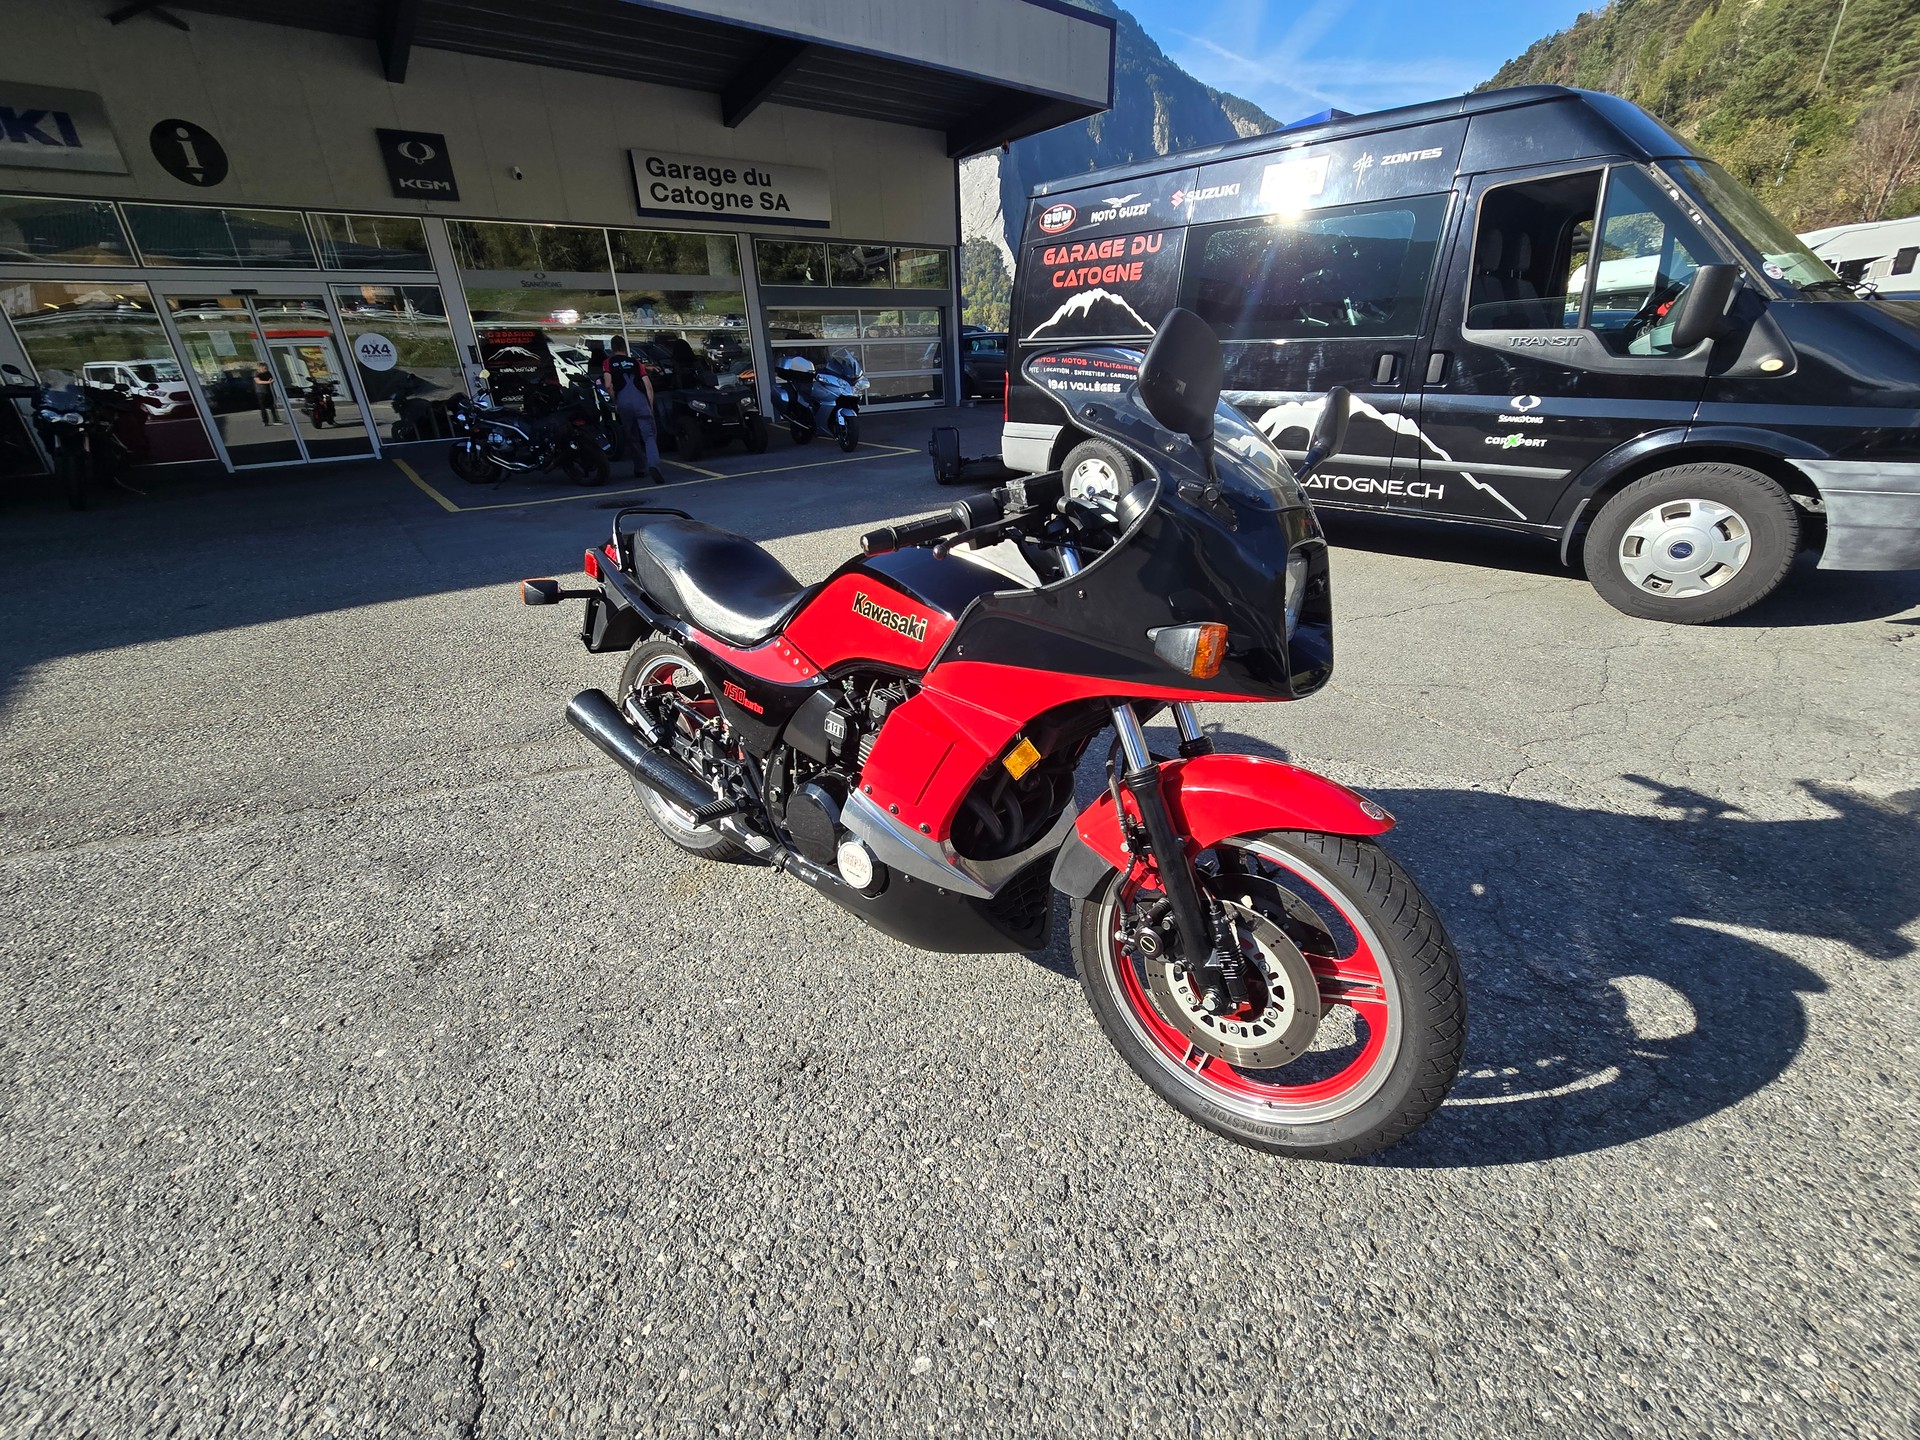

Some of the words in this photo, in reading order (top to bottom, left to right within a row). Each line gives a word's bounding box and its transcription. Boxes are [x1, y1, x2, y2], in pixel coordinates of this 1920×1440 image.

[0, 106, 82, 147] KI
[1381, 147, 1443, 166] ZONTES
[399, 178, 451, 191] KGM
[646, 157, 737, 187] Garage
[743, 168, 772, 187] du
[650, 182, 753, 211] Catogne
[760, 192, 791, 211] SA
[1185, 183, 1240, 201] SUZUKI
[1091, 209, 1117, 223] MOTO
[1119, 203, 1151, 218] GUZZI
[1044, 239, 1126, 265] GARAGE
[1131, 234, 1163, 256] DU
[1052, 262, 1144, 288] CATOGNE
[361, 344, 391, 354] 4X4
[1509, 336, 1584, 347] TRANSIT
[1048, 379, 1067, 390] 1941
[1070, 381, 1121, 392] VOLLÈGES
[1300, 474, 1444, 499] ATOGNE.CH
[852, 591, 928, 642] Kawasaki
[723, 680, 746, 705] 750
[1202, 1103, 1289, 1140] BRIDGESTONE
